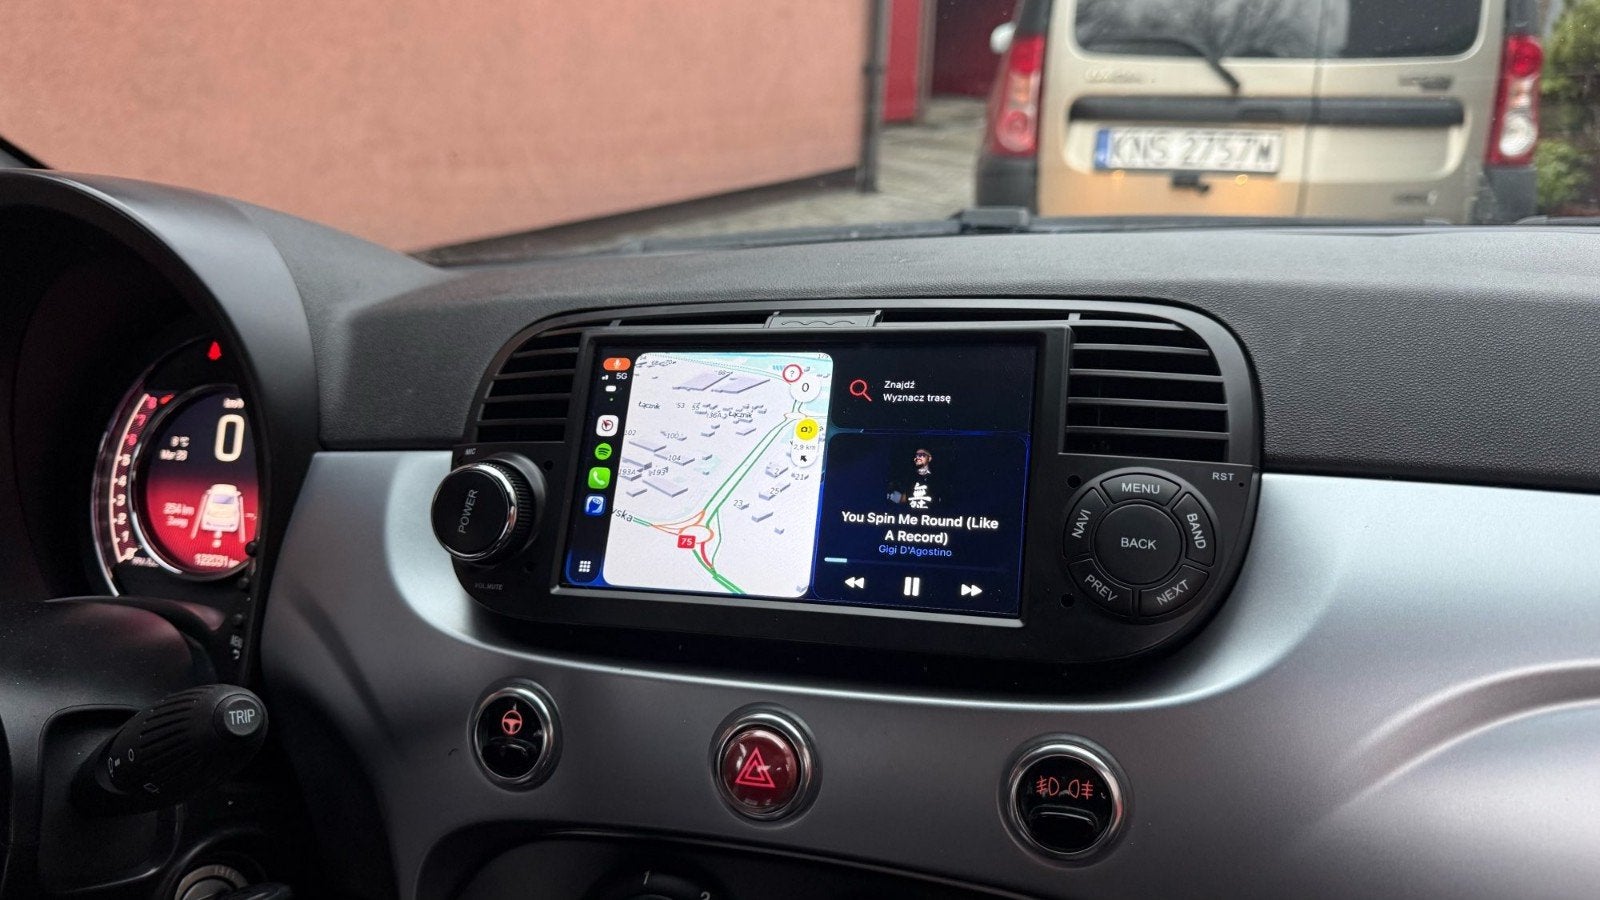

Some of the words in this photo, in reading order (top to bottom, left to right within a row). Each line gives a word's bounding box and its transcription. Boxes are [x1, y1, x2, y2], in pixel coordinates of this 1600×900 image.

[1112, 131, 1166, 167] KNS
[616, 372, 628, 380] 5G
[802, 382, 810, 393] 0
[884, 380, 915, 390] Znajdź
[883, 393, 925, 403] Wyznacz
[927, 393, 951, 404] trasę
[728, 411, 753, 419] Łącznik
[215, 414, 245, 462] 0
[666, 454, 681, 462] 104
[1212, 472, 1235, 481] RST
[769, 487, 780, 495] 25
[1121, 482, 1161, 494] MENU
[458, 489, 479, 534] POWER
[842, 511, 864, 523] You
[867, 512, 895, 526] Spin
[899, 514, 918, 526] Me
[921, 515, 963, 528] Round
[966, 516, 999, 530] (Like
[1071, 509, 1091, 538] NAVI
[1186, 513, 1207, 549] BAND
[681, 538, 693, 546] 75
[884, 530, 894, 541] A
[897, 531, 949, 546] Record)
[1121, 537, 1157, 550] BACK
[878, 545, 898, 555] Gigi
[900, 546, 953, 557] D'Agostino
[1084, 573, 1118, 602] PREV
[1156, 579, 1189, 606] NEXT
[228, 708, 256, 725] TRIP
[643, 870, 650, 885] 1
